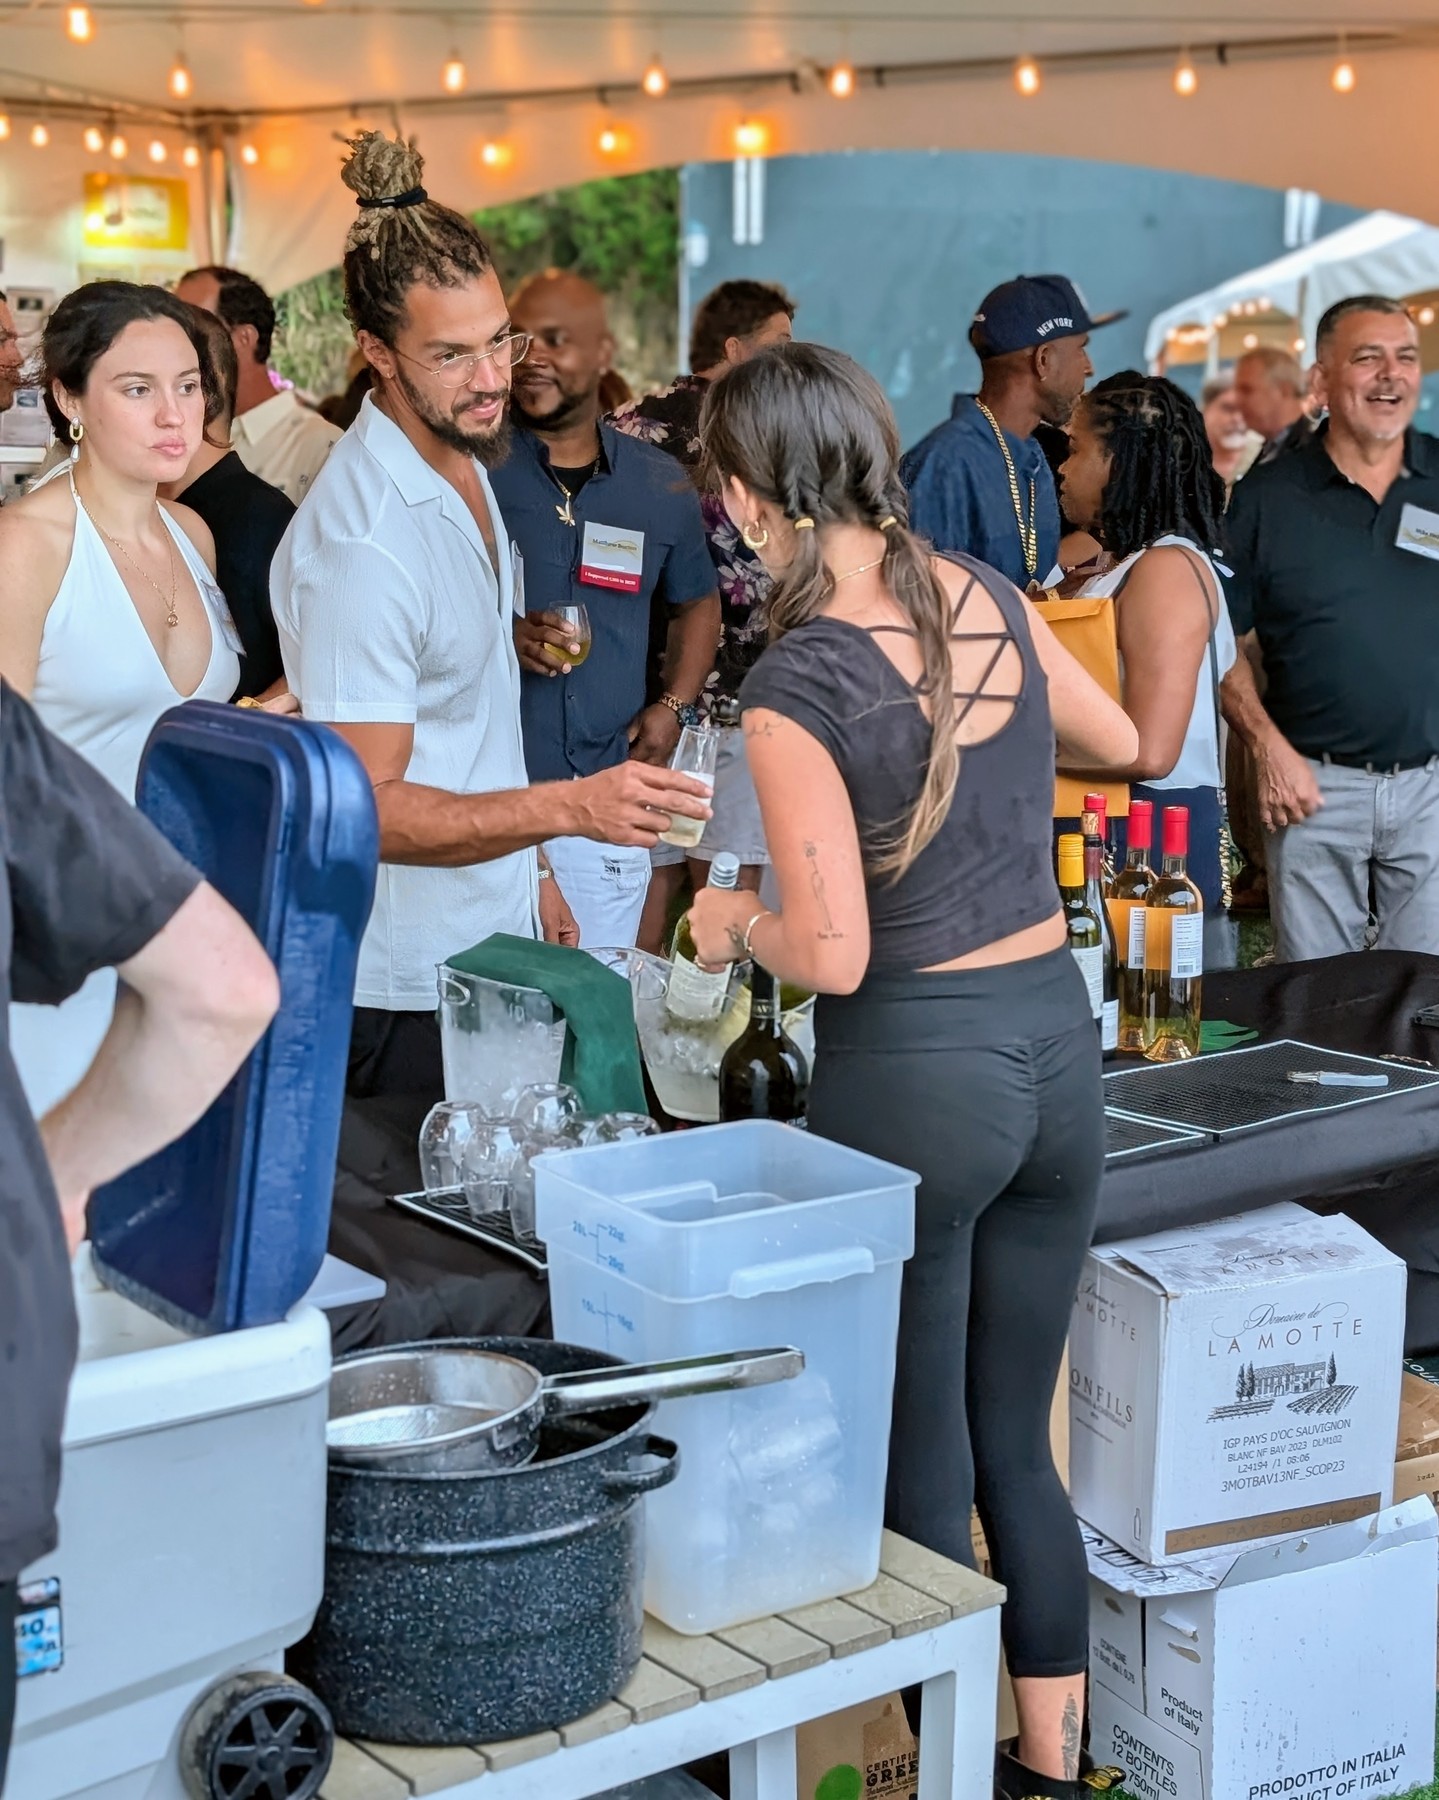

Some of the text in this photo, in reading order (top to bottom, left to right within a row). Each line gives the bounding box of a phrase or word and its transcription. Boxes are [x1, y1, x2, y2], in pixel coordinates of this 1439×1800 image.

[1036, 317, 1074, 337] NEW YORK
[1245, 1249, 1340, 1272] MOTTE
[1086, 1302, 1136, 1342] MOTTE
[1228, 1303, 1306, 1334] Domaine
[1208, 1319, 1362, 1357] LA MOTTE
[1403, 1358, 1439, 1386] LOUI
[1070, 1368, 1133, 1423] ONFILS
[1223, 1419, 1351, 1450] IGP PAYS D'OC SAUVIGNON
[1228, 1435, 1343, 1462] BLANC NF BAV 2023 DLM102
[1221, 1460, 1345, 1493] 3MOTBAV13NF_SCOP23
[1238, 1461, 1268, 1473] L24194
[1272, 1459, 1281, 1470] /1
[1225, 1521, 1272, 1540] PAYS
[1161, 1687, 1203, 1722] Product
[1164, 1706, 1200, 1736] of Italy
[866, 1751, 918, 1774] CERTIFIE
[1113, 1724, 1175, 1776] CONTENTS
[866, 1760, 918, 1787] GREE
[1112, 1741, 1178, 1796] 12 BOTTLES
[1249, 1743, 1406, 1800] PRODOTTO IN ITALIA
[1288, 1765, 1400, 1800] UCT OF ITALY
[1128, 1769, 1160, 1800] 750ml
